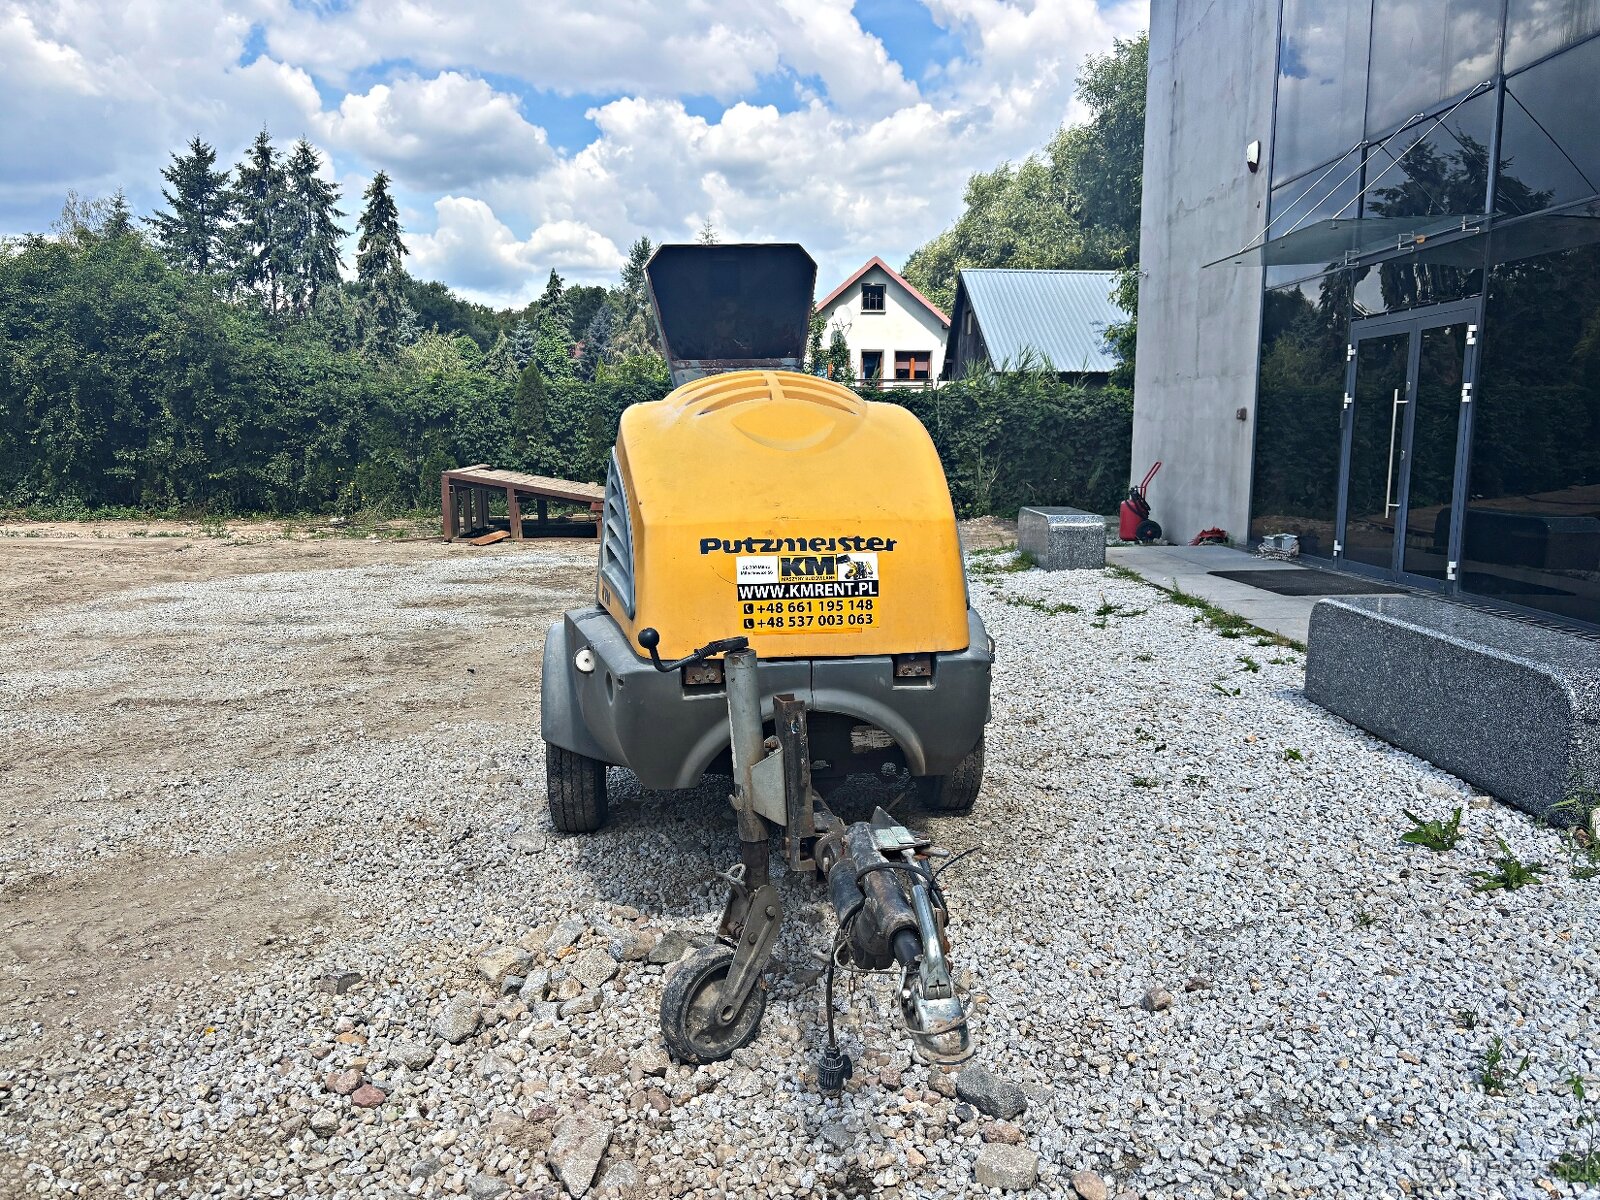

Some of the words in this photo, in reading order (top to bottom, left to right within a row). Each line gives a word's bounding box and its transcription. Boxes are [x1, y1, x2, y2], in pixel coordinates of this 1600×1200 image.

[700, 535, 898, 554] Putzmeister
[781, 556, 835, 577] KM
[738, 582, 878, 599] WWW.KMRENT.PL
[757, 602, 784, 614] +48
[788, 602, 813, 613] 661
[818, 600, 844, 612] 195
[848, 599, 874, 611] 148
[757, 617, 784, 628] +48
[788, 616, 814, 628] 537
[818, 615, 844, 626] 003
[848, 613, 874, 625] 063
